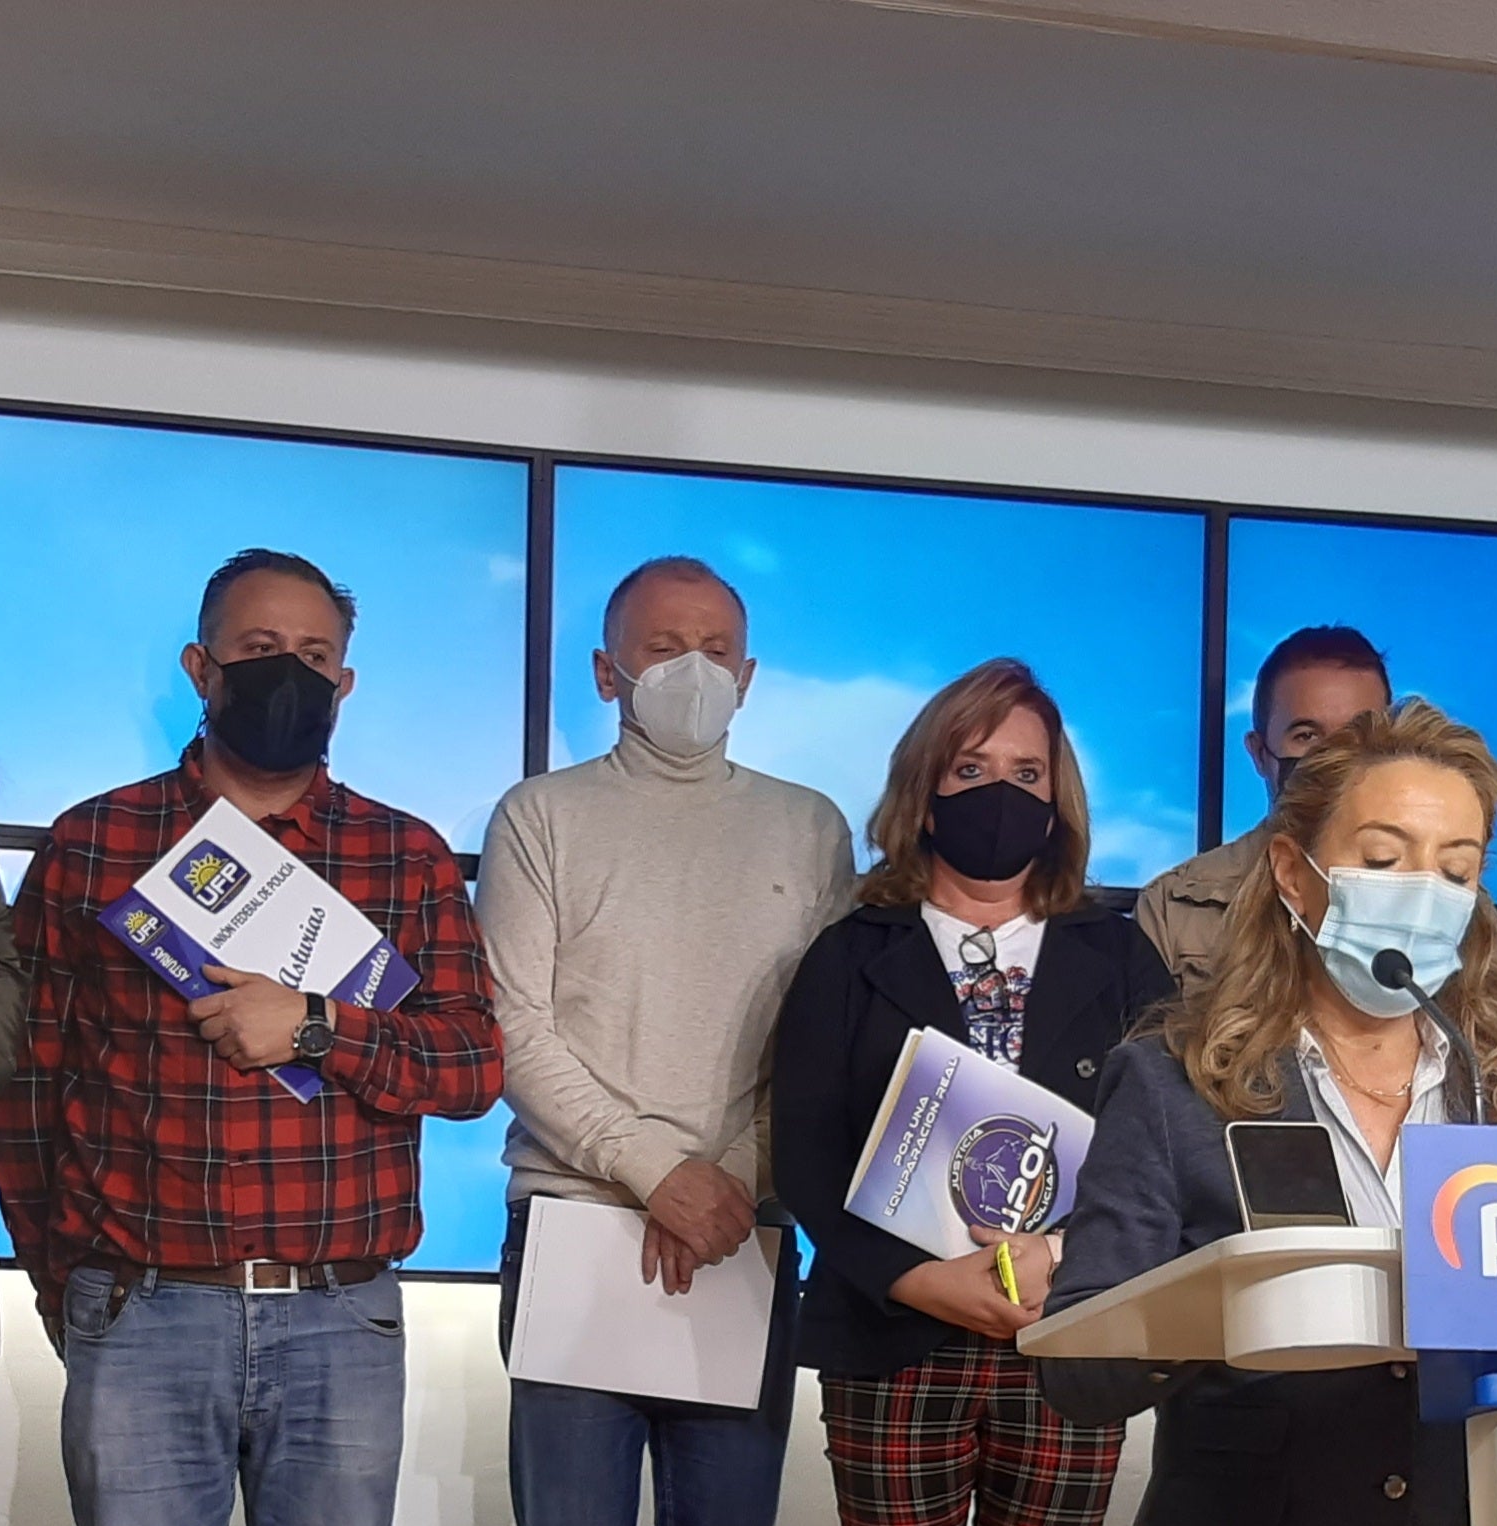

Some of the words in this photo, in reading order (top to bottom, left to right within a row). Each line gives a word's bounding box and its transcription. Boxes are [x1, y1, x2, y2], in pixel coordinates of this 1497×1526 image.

[196, 862, 238, 907] UFP
[131, 916, 159, 944] UFP
[210, 923, 236, 950] UNIÓN
[230, 898, 263, 929] FEDERAL
[259, 887, 272, 902] DE
[279, 906, 326, 989] Asturias
[151, 946, 192, 982] ASTURIAS
[935, 1056, 960, 1100] REAL
[893, 1132, 915, 1167] POR
[909, 1096, 929, 1130] UNA
[950, 1128, 984, 1192] JUSTICIA
[1002, 1122, 1056, 1233] UPOL
[1025, 1164, 1053, 1231] POLICIAL
